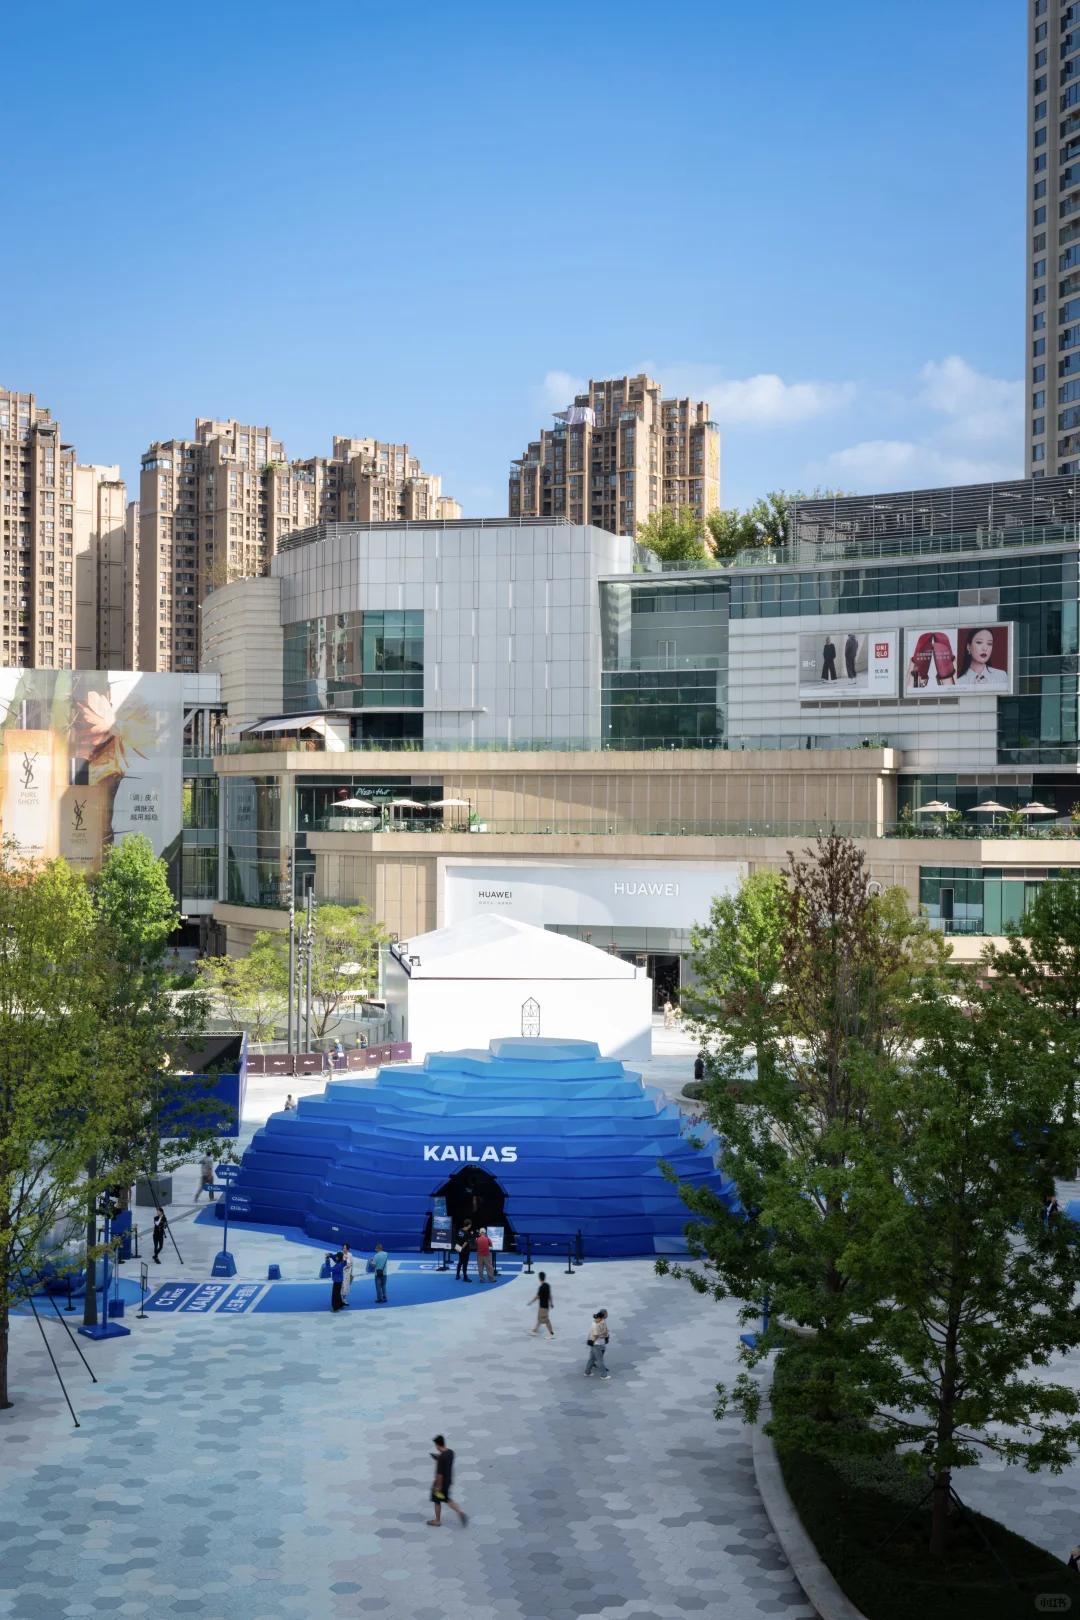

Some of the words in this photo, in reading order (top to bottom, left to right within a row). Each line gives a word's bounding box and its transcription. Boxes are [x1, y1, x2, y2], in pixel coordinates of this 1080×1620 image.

[355, 787, 375, 796] Pizza
[375, 787, 391, 796] Hut
[133, 805, 155, 813] 调肤况
[129, 813, 159, 821] 越用越稳
[614, 882, 680, 897] HUAWEI
[478, 891, 512, 899] HUAWEI
[423, 1145, 518, 1163] KAILAS
[186, 1285, 223, 1311] KAILAS
